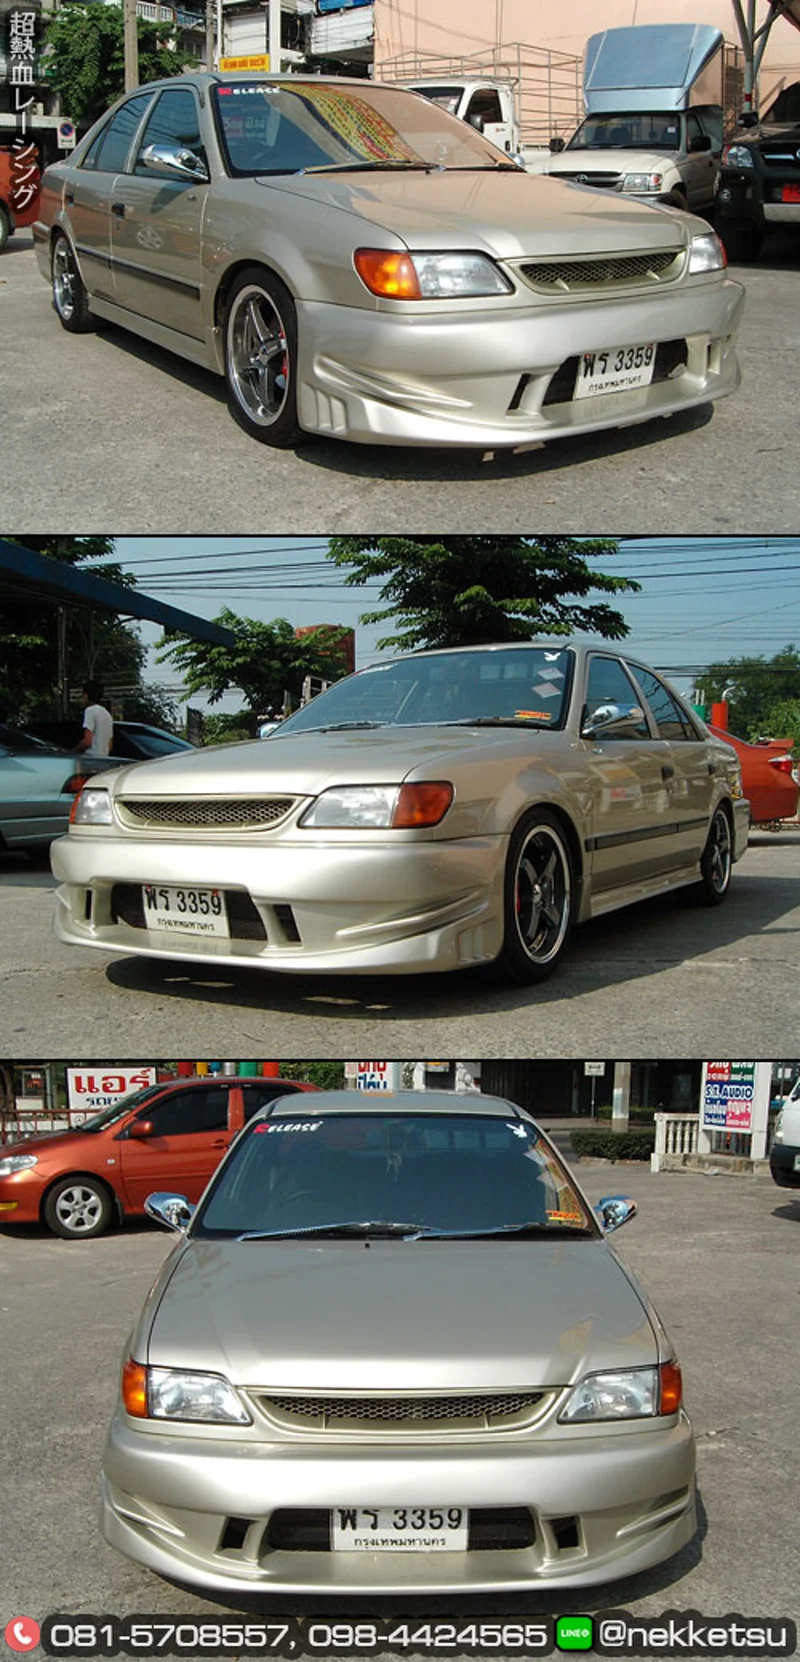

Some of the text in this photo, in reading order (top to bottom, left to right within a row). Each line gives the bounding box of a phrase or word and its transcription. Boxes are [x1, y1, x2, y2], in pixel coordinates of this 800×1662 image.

[614, 343, 654, 372] 3359
[176, 890, 222, 916] 3359
[722, 1086, 753, 1099] AUDIO
[254, 1122, 323, 1134] RELEASE
[392, 1508, 462, 1530] 3359
[354, 1537, 446, 1549] กรุงเทพมหานคร
